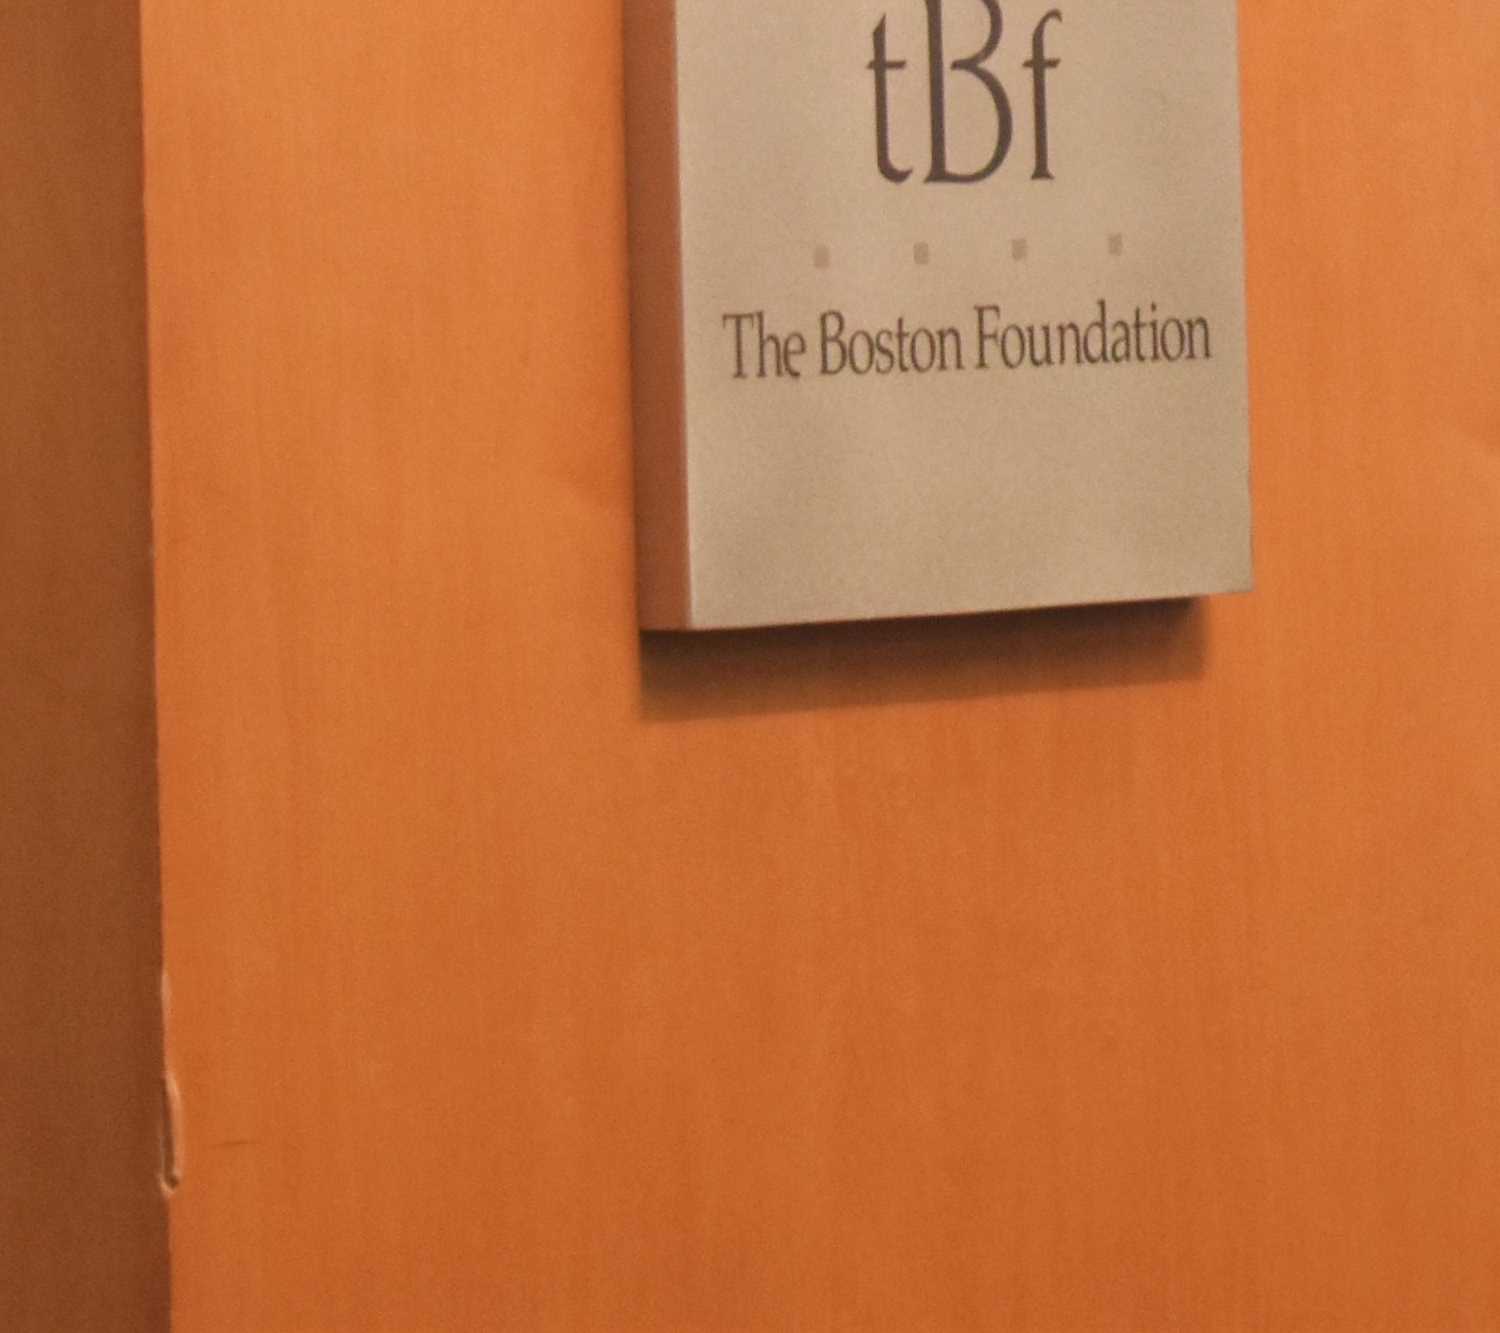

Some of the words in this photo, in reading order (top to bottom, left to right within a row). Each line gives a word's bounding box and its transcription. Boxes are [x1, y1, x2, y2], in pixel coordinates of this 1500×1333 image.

[722, 310, 805, 379] The
[820, 309, 965, 376] Boston
[973, 299, 1213, 370] Foundation
